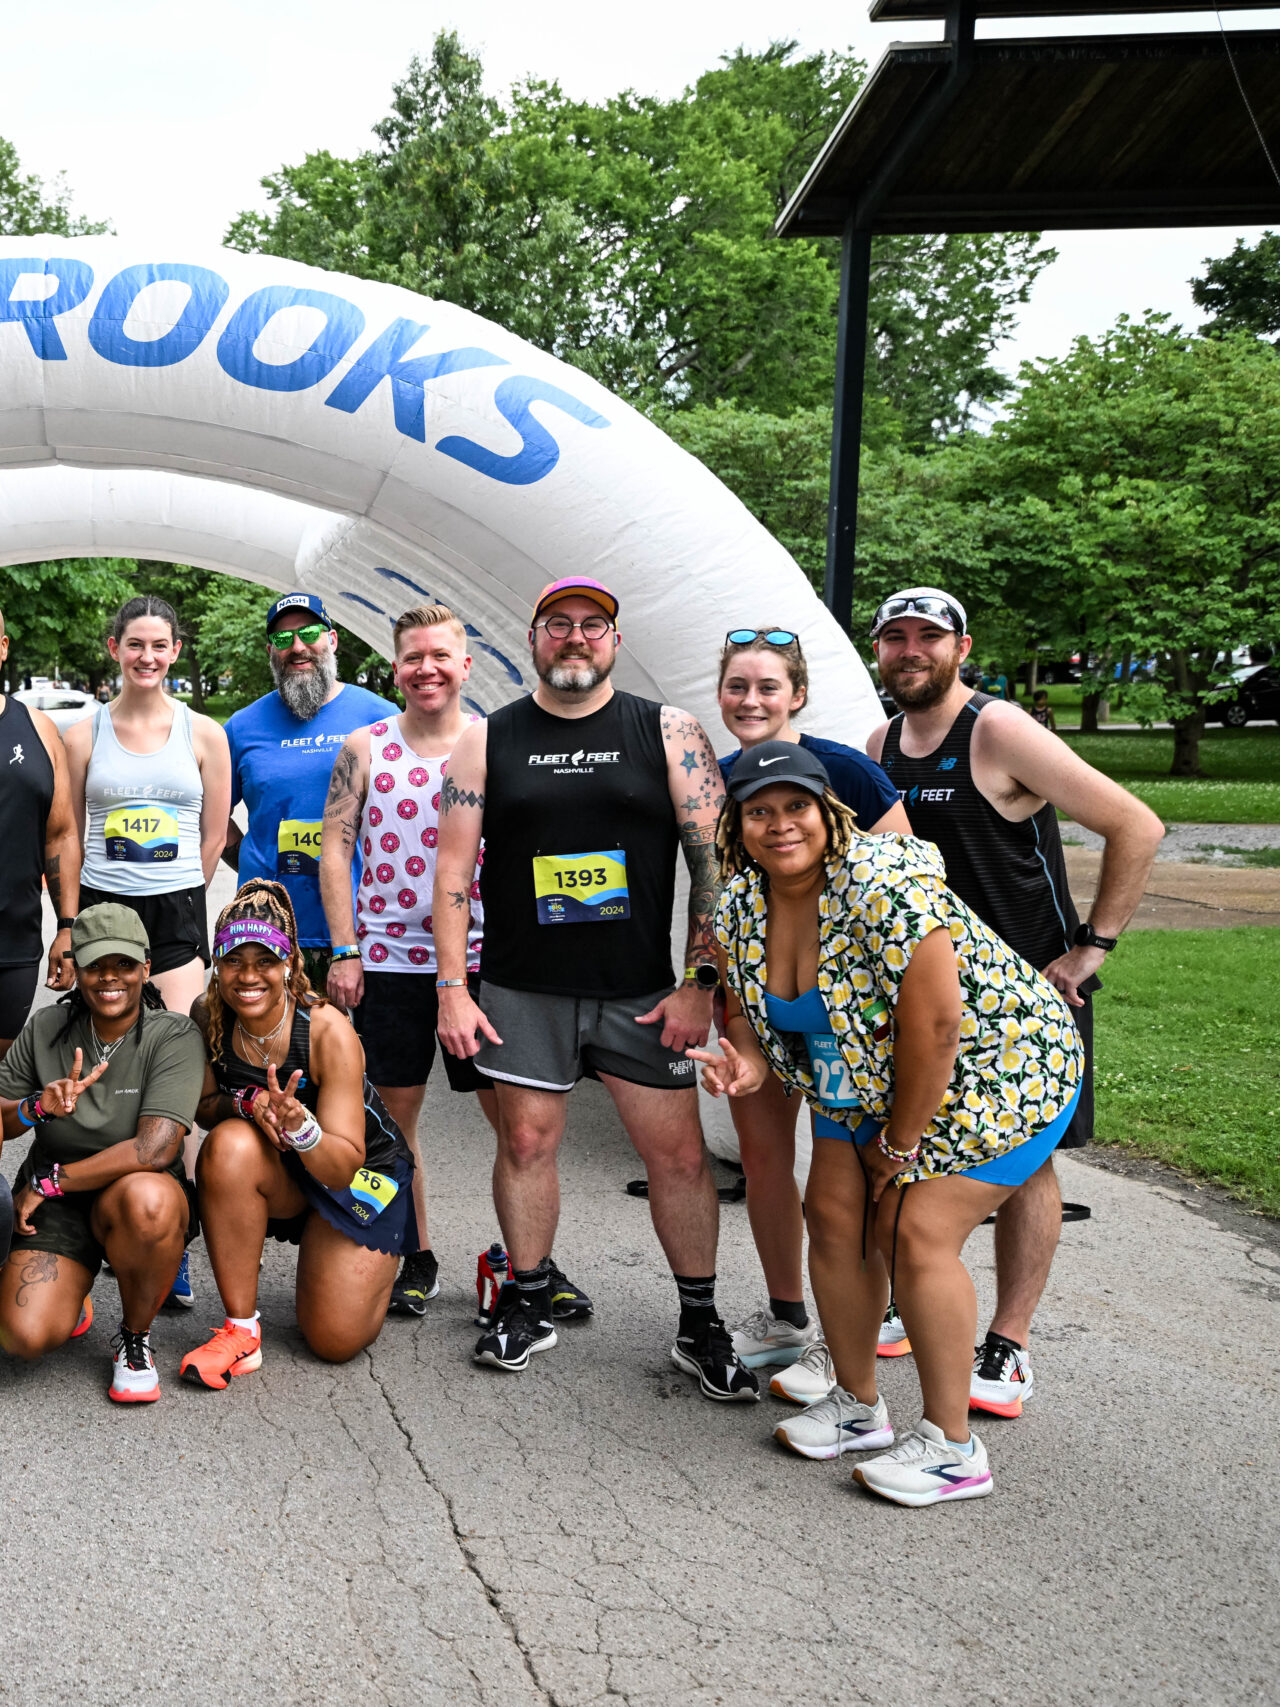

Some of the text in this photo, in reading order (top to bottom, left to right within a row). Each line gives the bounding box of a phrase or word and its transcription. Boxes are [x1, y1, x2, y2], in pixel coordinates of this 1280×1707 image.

[279, 597, 306, 609] NASH
[280, 737, 313, 748] FLEET
[301, 746, 333, 755] NASHVILLE
[528, 751, 621, 764] FLEET FEET
[103, 786, 185, 799] FLEET FEET
[920, 788, 955, 802] FEET
[122, 818, 161, 833] 1417
[153, 850, 174, 858] 2024
[554, 867, 607, 889] 1393
[599, 905, 625, 916] 2024
[230, 923, 273, 937] RUN HAPPY
[814, 1040, 833, 1049] FLEET
[668, 1059, 689, 1070] FLEET
[672, 1066, 689, 1076] FEET
[358, 1170, 382, 1191] 46
[351, 1202, 370, 1221] 2024
